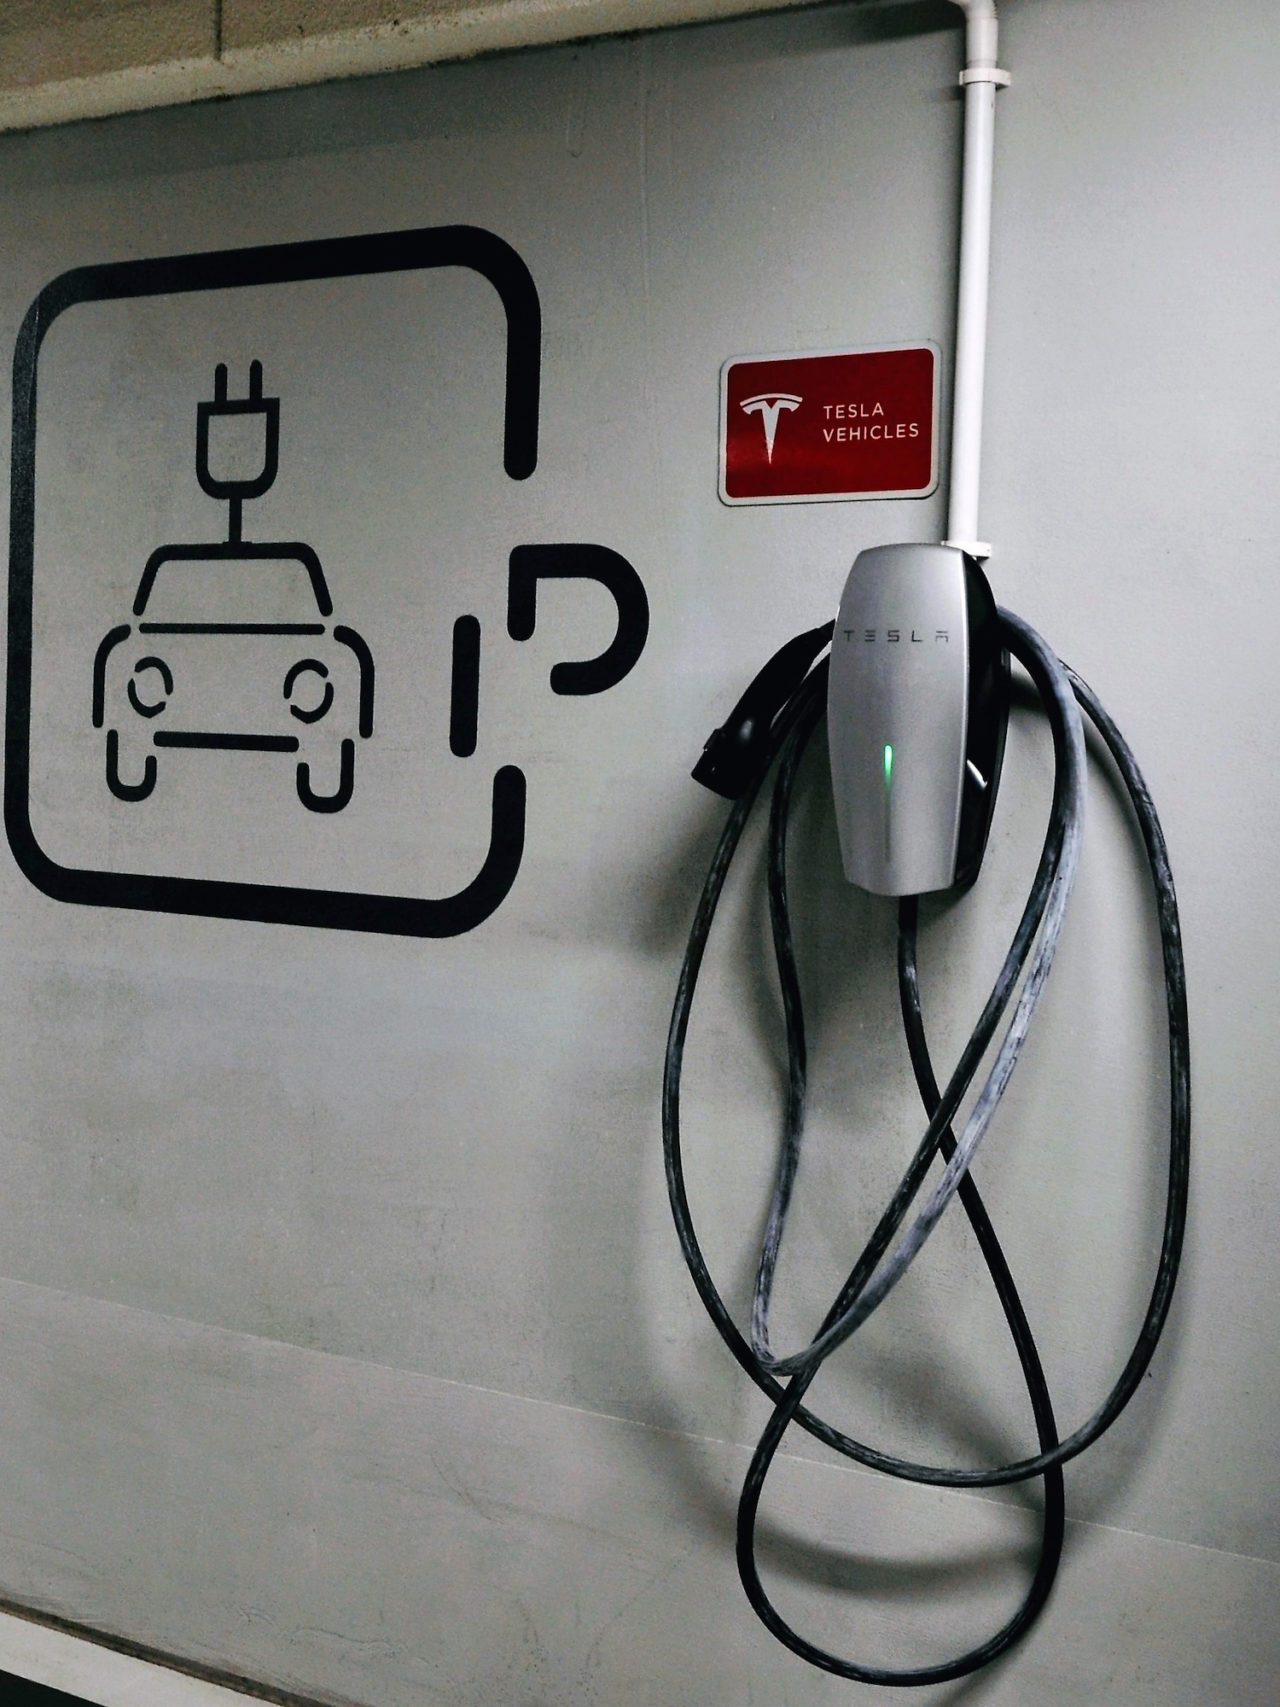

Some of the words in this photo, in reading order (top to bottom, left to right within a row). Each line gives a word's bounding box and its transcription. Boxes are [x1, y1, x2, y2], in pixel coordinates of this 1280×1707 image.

[823, 402, 885, 420] TESLA
[822, 422, 919, 443] VEHICLES
[842, 629, 949, 643] TESLA
